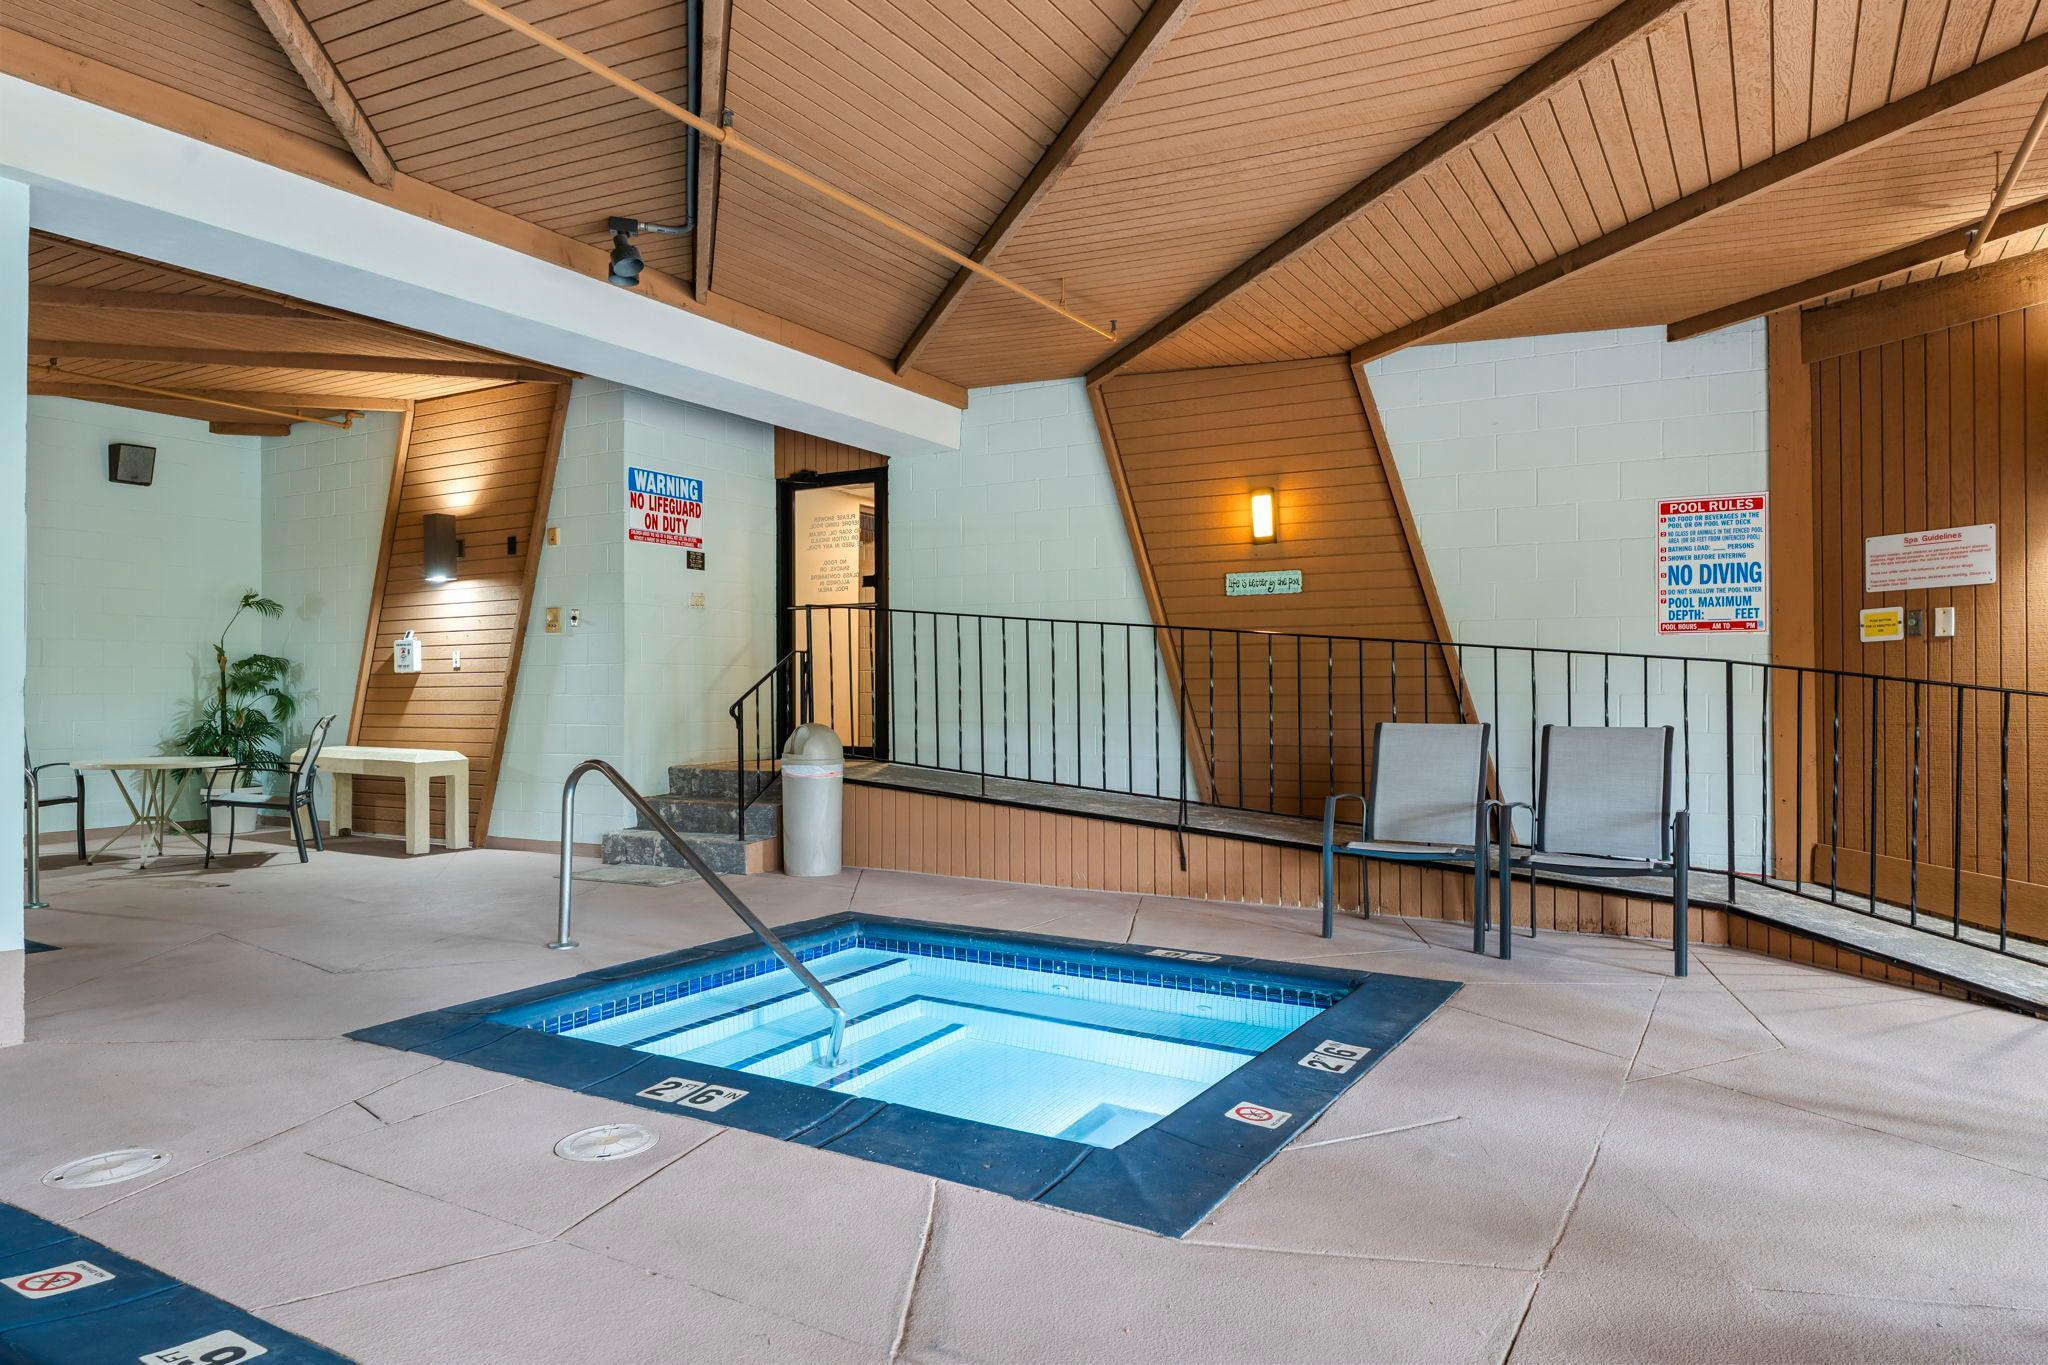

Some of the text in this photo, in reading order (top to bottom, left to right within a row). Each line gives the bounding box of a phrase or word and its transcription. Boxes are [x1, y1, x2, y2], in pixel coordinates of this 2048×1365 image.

[634, 469, 698, 500] WARNING
[630, 492, 701, 518] NO LIFEGUARD
[1669, 499, 1754, 513] POOL RULES
[645, 513, 688, 534] ON DUTY
[1705, 513, 1738, 521] BEVERAGES
[1922, 532, 1962, 541] Guidelines
[1668, 564, 1692, 586] NO
[1699, 562, 1762, 585] DIVING
[1277, 577, 1287, 586] the
[1668, 597, 1694, 608] POOL
[1698, 595, 1752, 607] MAXIMUM
[1668, 608, 1760, 620] DEPTH: FEET
[1323, 1046, 1357, 1057] 6
[1307, 1060, 1345, 1071] 2
[644, 1081, 682, 1096] 2
[688, 1089, 723, 1104] 6
[724, 1092, 741, 1100] IN
